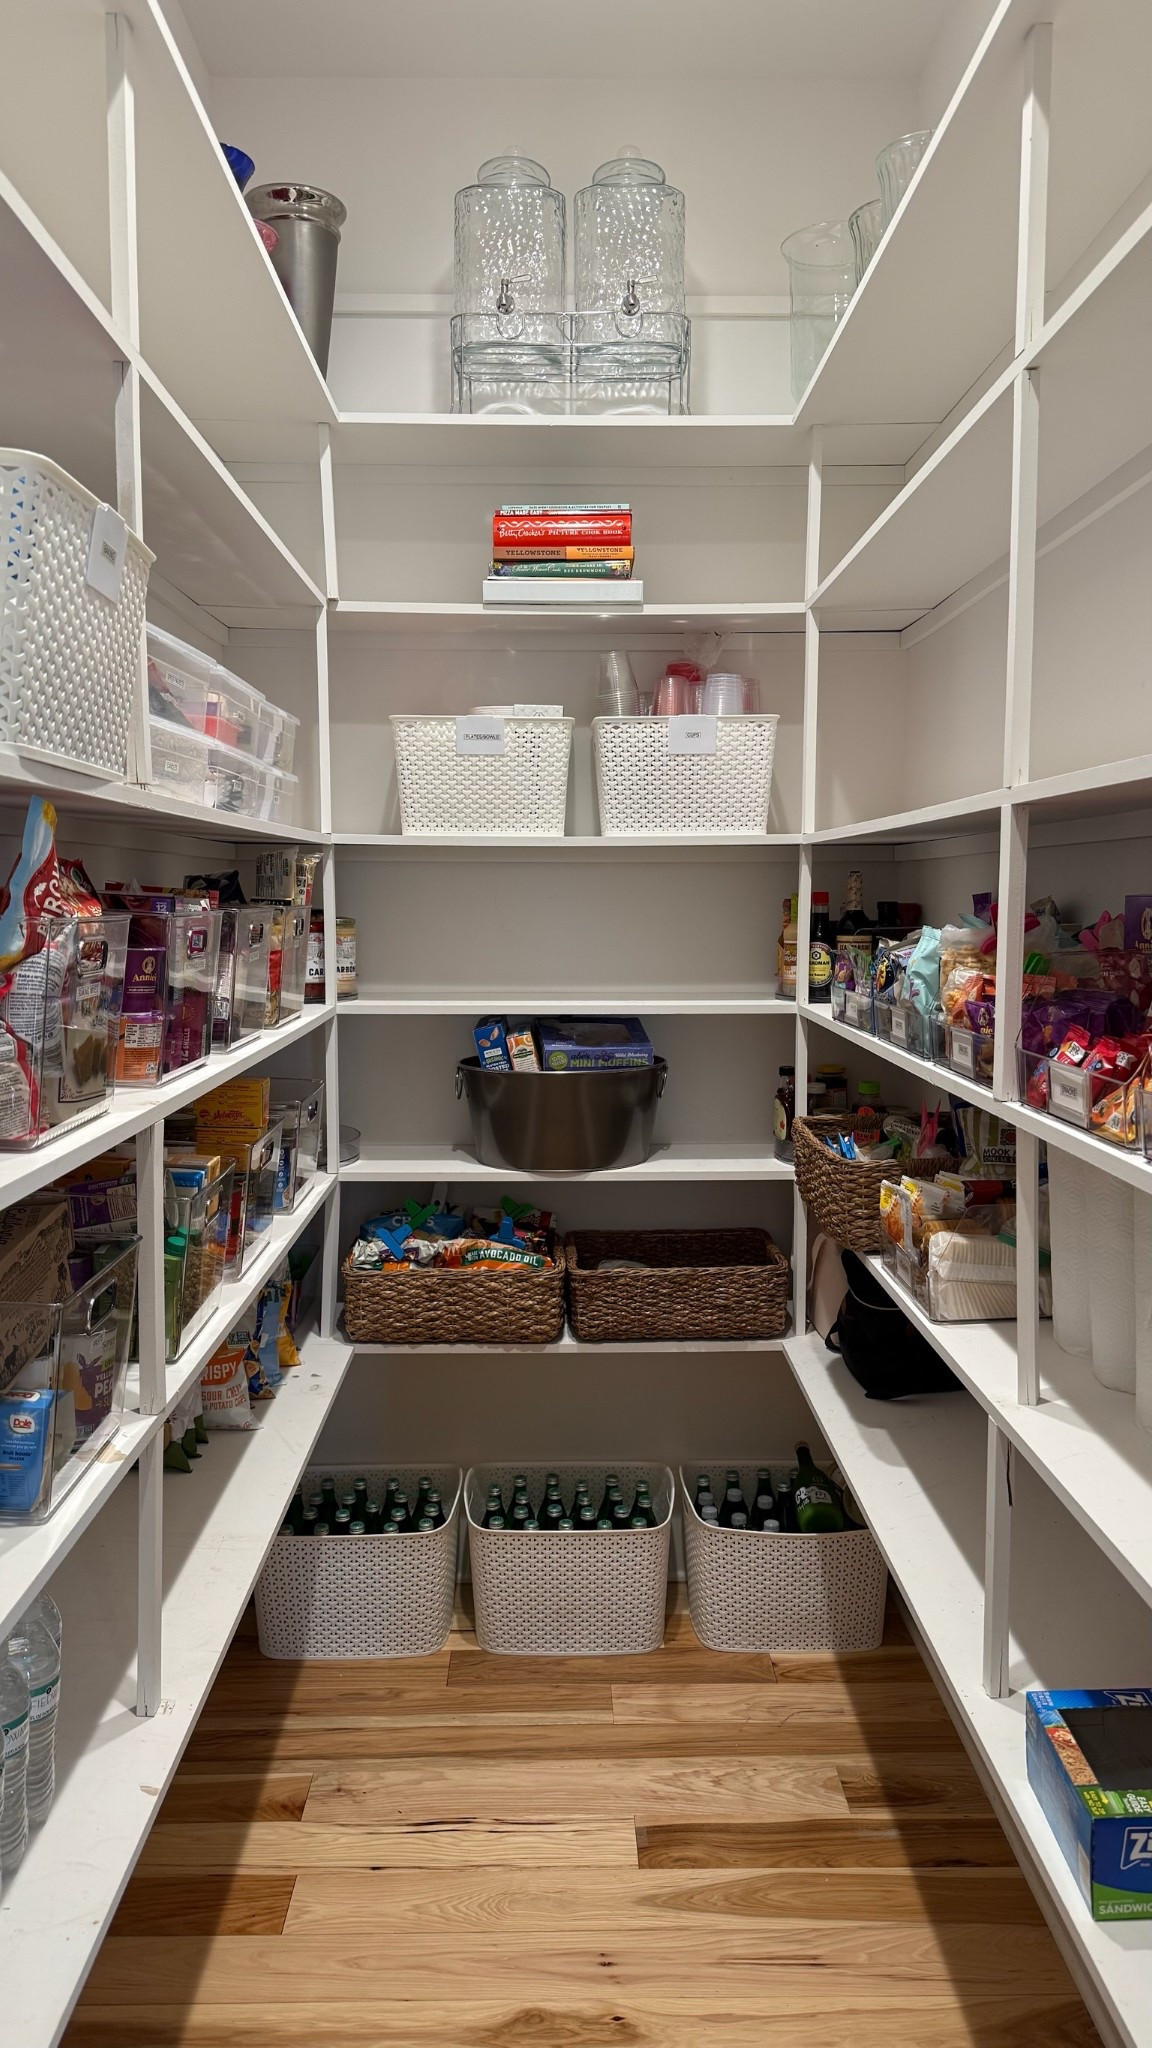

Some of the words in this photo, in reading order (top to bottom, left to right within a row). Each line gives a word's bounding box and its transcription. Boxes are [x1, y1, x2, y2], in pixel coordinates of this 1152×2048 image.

[499, 528, 517, 539] Betty
[570, 1059, 594, 1067] MINI
[598, 1058, 649, 1067] MUFFINS
[392, 1216, 435, 1227] CHS
[479, 1249, 521, 1261] AVOCADO
[523, 1256, 539, 1266] OIL
[202, 1391, 222, 1401] SOUR
[209, 1400, 233, 1410] POTATO
[13, 1418, 32, 1427] Dole
[1126, 1793, 1143, 1814] GUIDE
